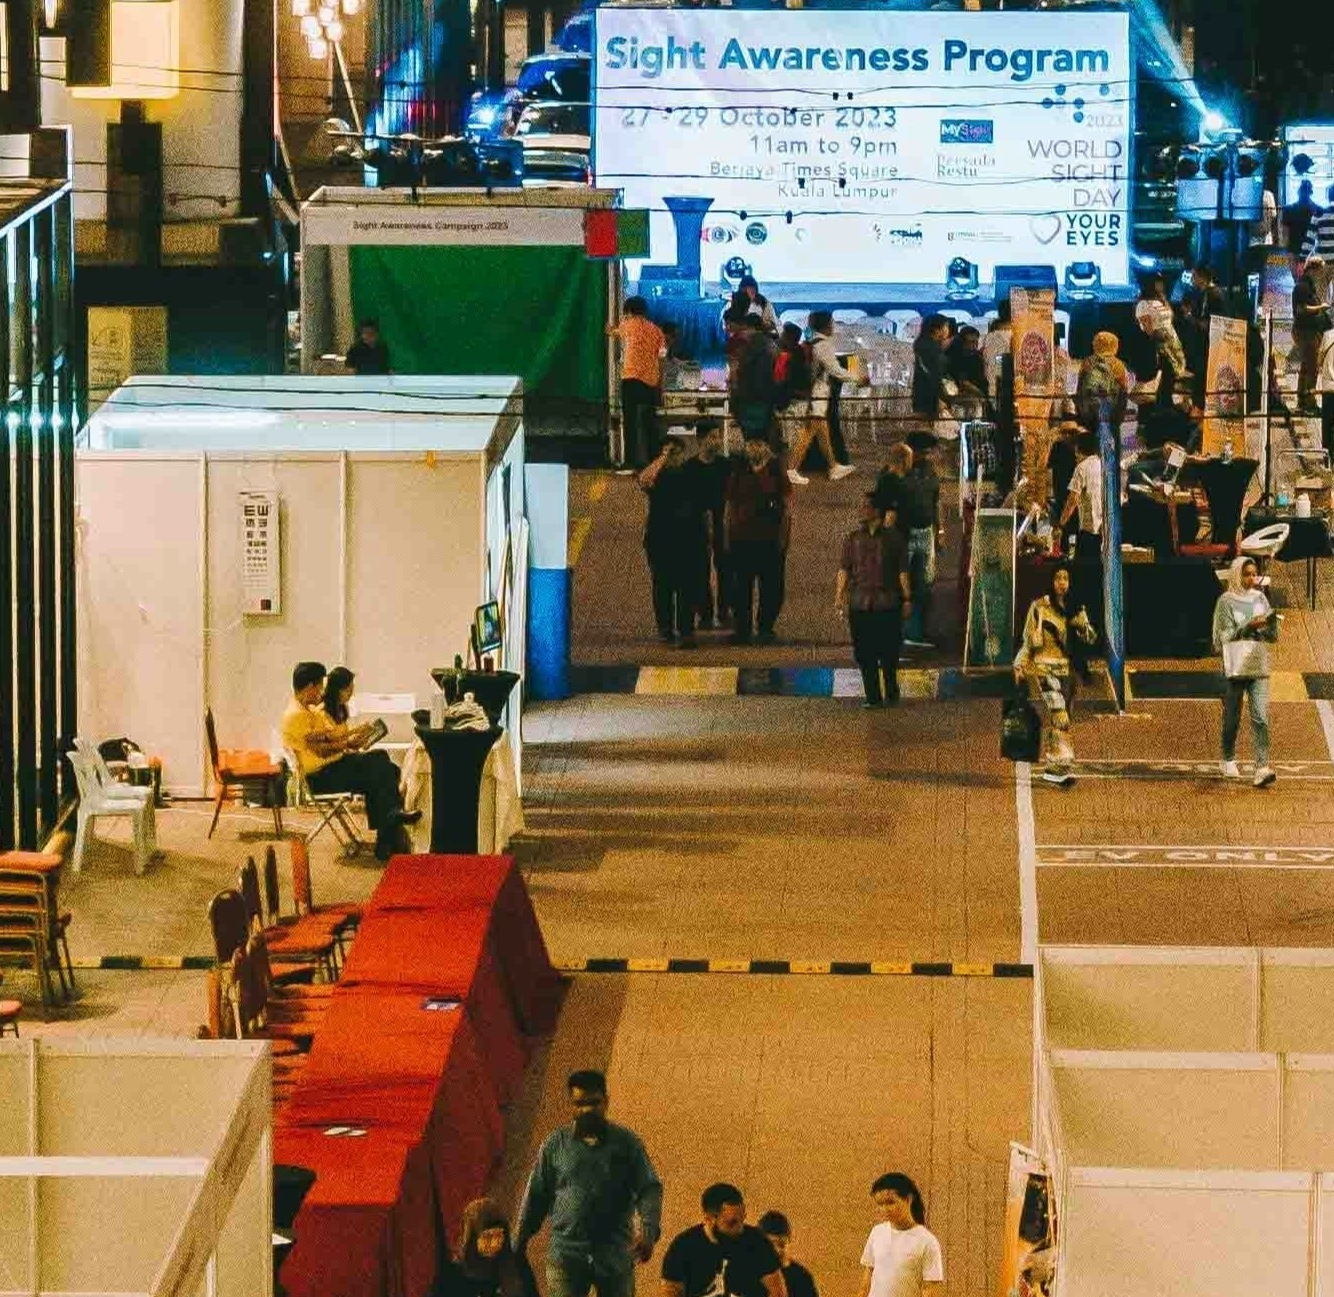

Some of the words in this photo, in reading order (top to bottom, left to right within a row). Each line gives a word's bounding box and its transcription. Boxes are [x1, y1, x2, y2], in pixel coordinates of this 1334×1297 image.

[605, 36, 706, 79] Sight
[718, 37, 928, 71] Awareness
[944, 39, 1109, 81] Program
[622, 107, 648, 127] 27
[679, 107, 708, 127] 29
[720, 106, 824, 127] October
[835, 106, 897, 127] 2023
[750, 135, 808, 154] 11am
[819, 136, 839, 154] to
[850, 136, 897, 157] 9pm
[1027, 139, 1122, 158] WORLD
[782, 162, 830, 176] Times
[838, 162, 898, 180] Square
[1051, 164, 1122, 183] SIGHT
[778, 184, 824, 198] Kuala
[833, 184, 896, 200] Lumpur
[1073, 188, 1121, 207] DAY
[353, 220, 377, 231] Sight
[380, 221, 432, 230] Awareness
[435, 220, 483, 231] Campaign
[1067, 214, 1121, 229] YOUR
[1067, 231, 1119, 246] EYES
